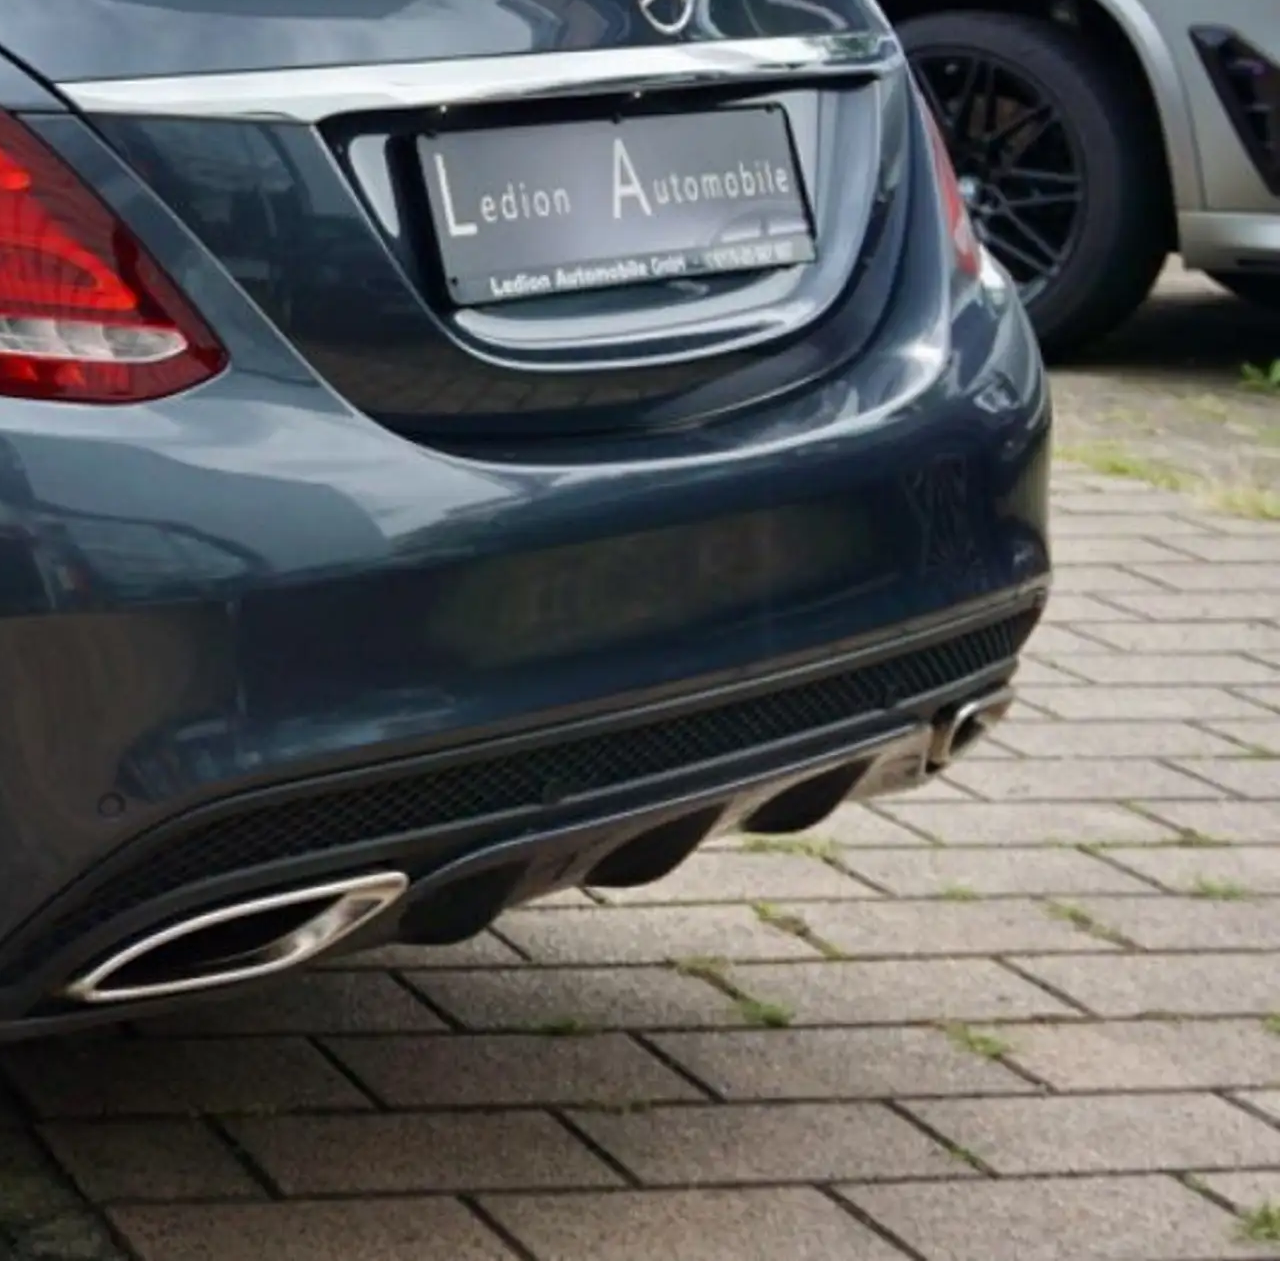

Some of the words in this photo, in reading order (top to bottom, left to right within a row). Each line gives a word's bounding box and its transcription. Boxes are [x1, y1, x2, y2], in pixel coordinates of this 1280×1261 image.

[434, 153, 572, 237] Ledion
[612, 137, 790, 220] Automobile
[490, 274, 552, 297] Ledion
[555, 259, 649, 288] Automobile
